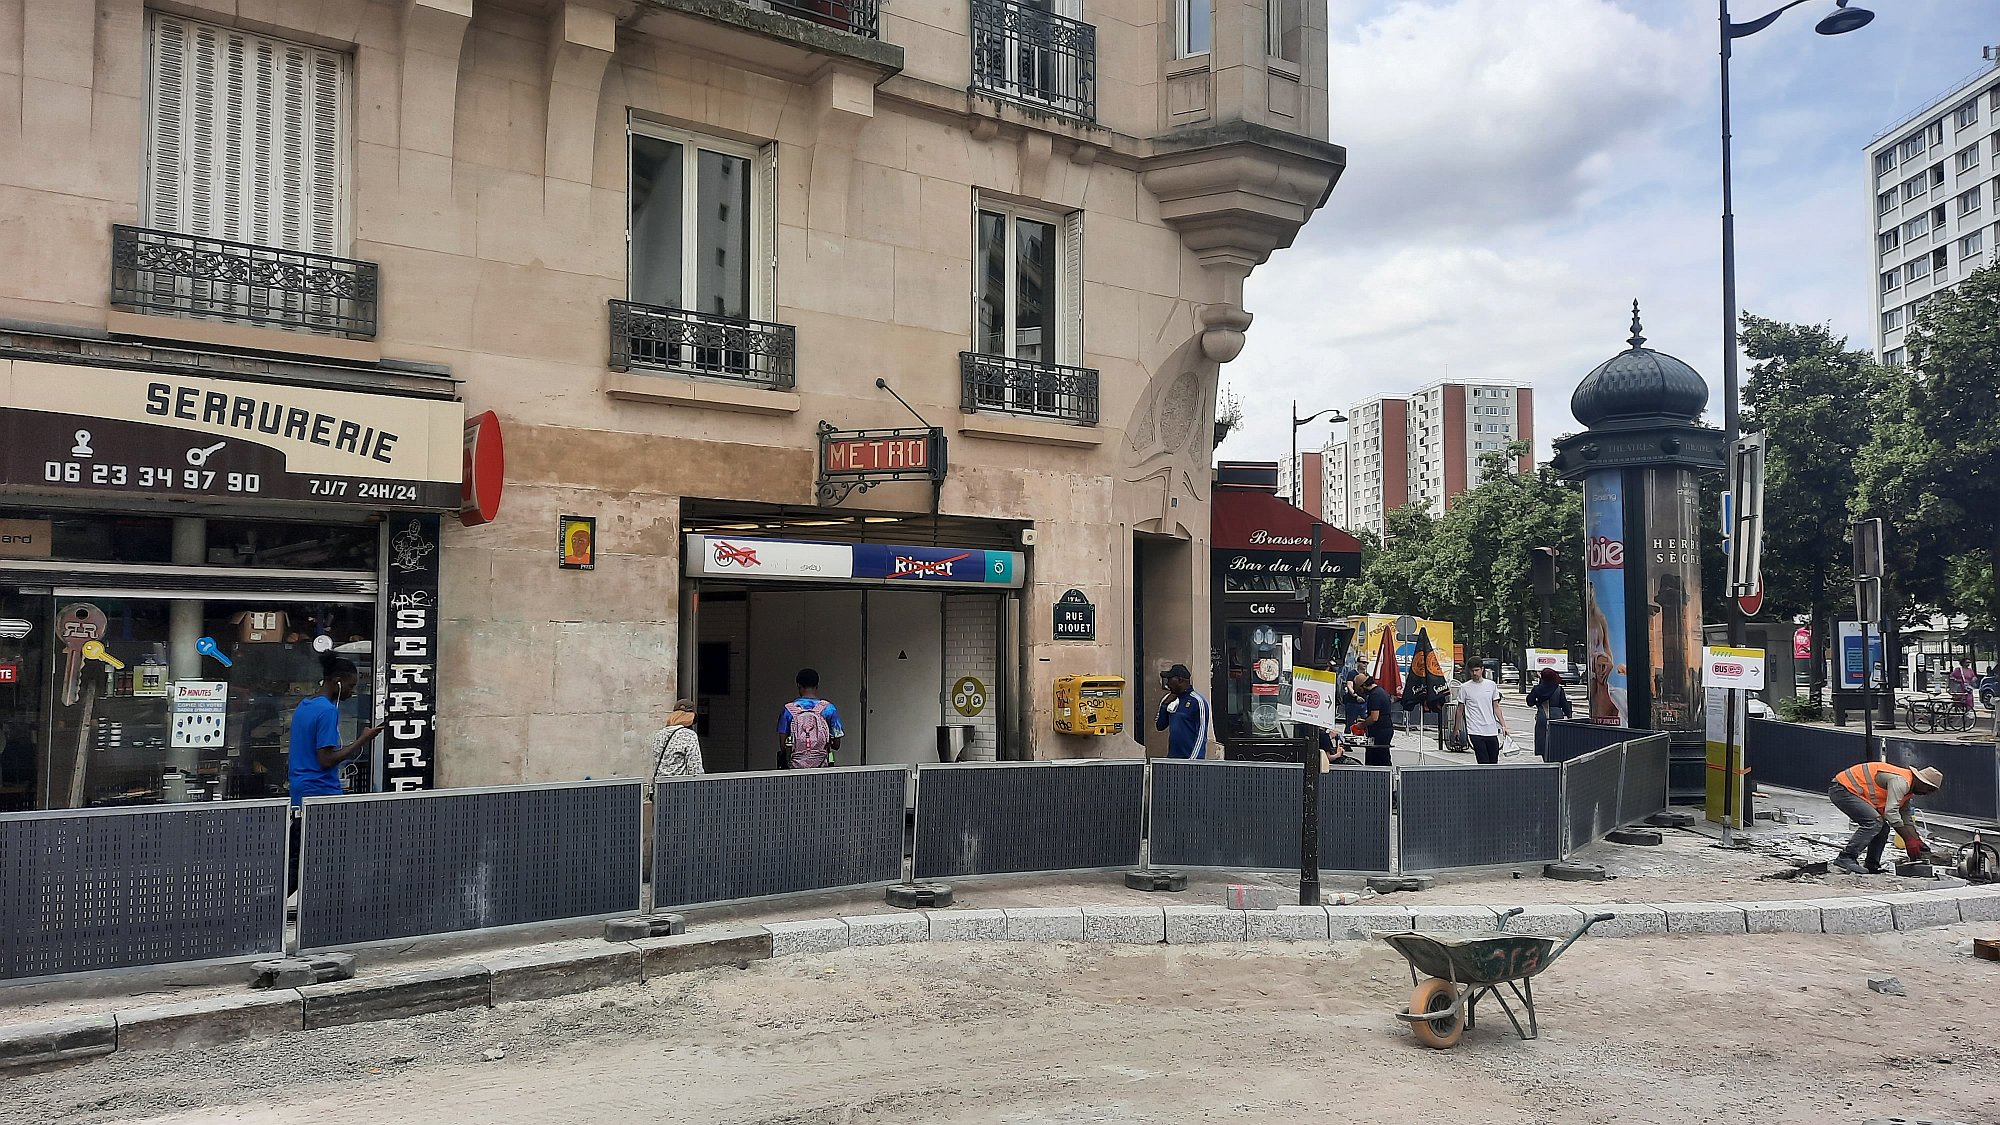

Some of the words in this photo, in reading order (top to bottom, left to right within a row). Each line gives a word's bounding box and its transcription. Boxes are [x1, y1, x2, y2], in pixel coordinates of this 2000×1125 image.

[145, 381, 399, 464] SERRURERIE
[830, 440, 924, 468] METRO
[45, 461, 81, 483] 06
[92, 464, 127, 485] 23
[138, 467, 173, 488] 34
[183, 469, 216, 490] 97
[227, 472, 260, 493] 90
[309, 479, 348, 496] 7J/7
[358, 483, 417, 500] 24H/24
[895, 555, 953, 579] Riquet
[1230, 556, 1265, 571] Bar
[1269, 558, 1292, 572] du
[1296, 558, 1343, 573] Mtro
[1065, 612, 1083, 621] RUE
[1250, 603, 1276, 614] Café
[1058, 623, 1091, 633] RIQUET
[1714, 665, 1728, 673] BUS
[187, 689, 212, 697] MINUTES
